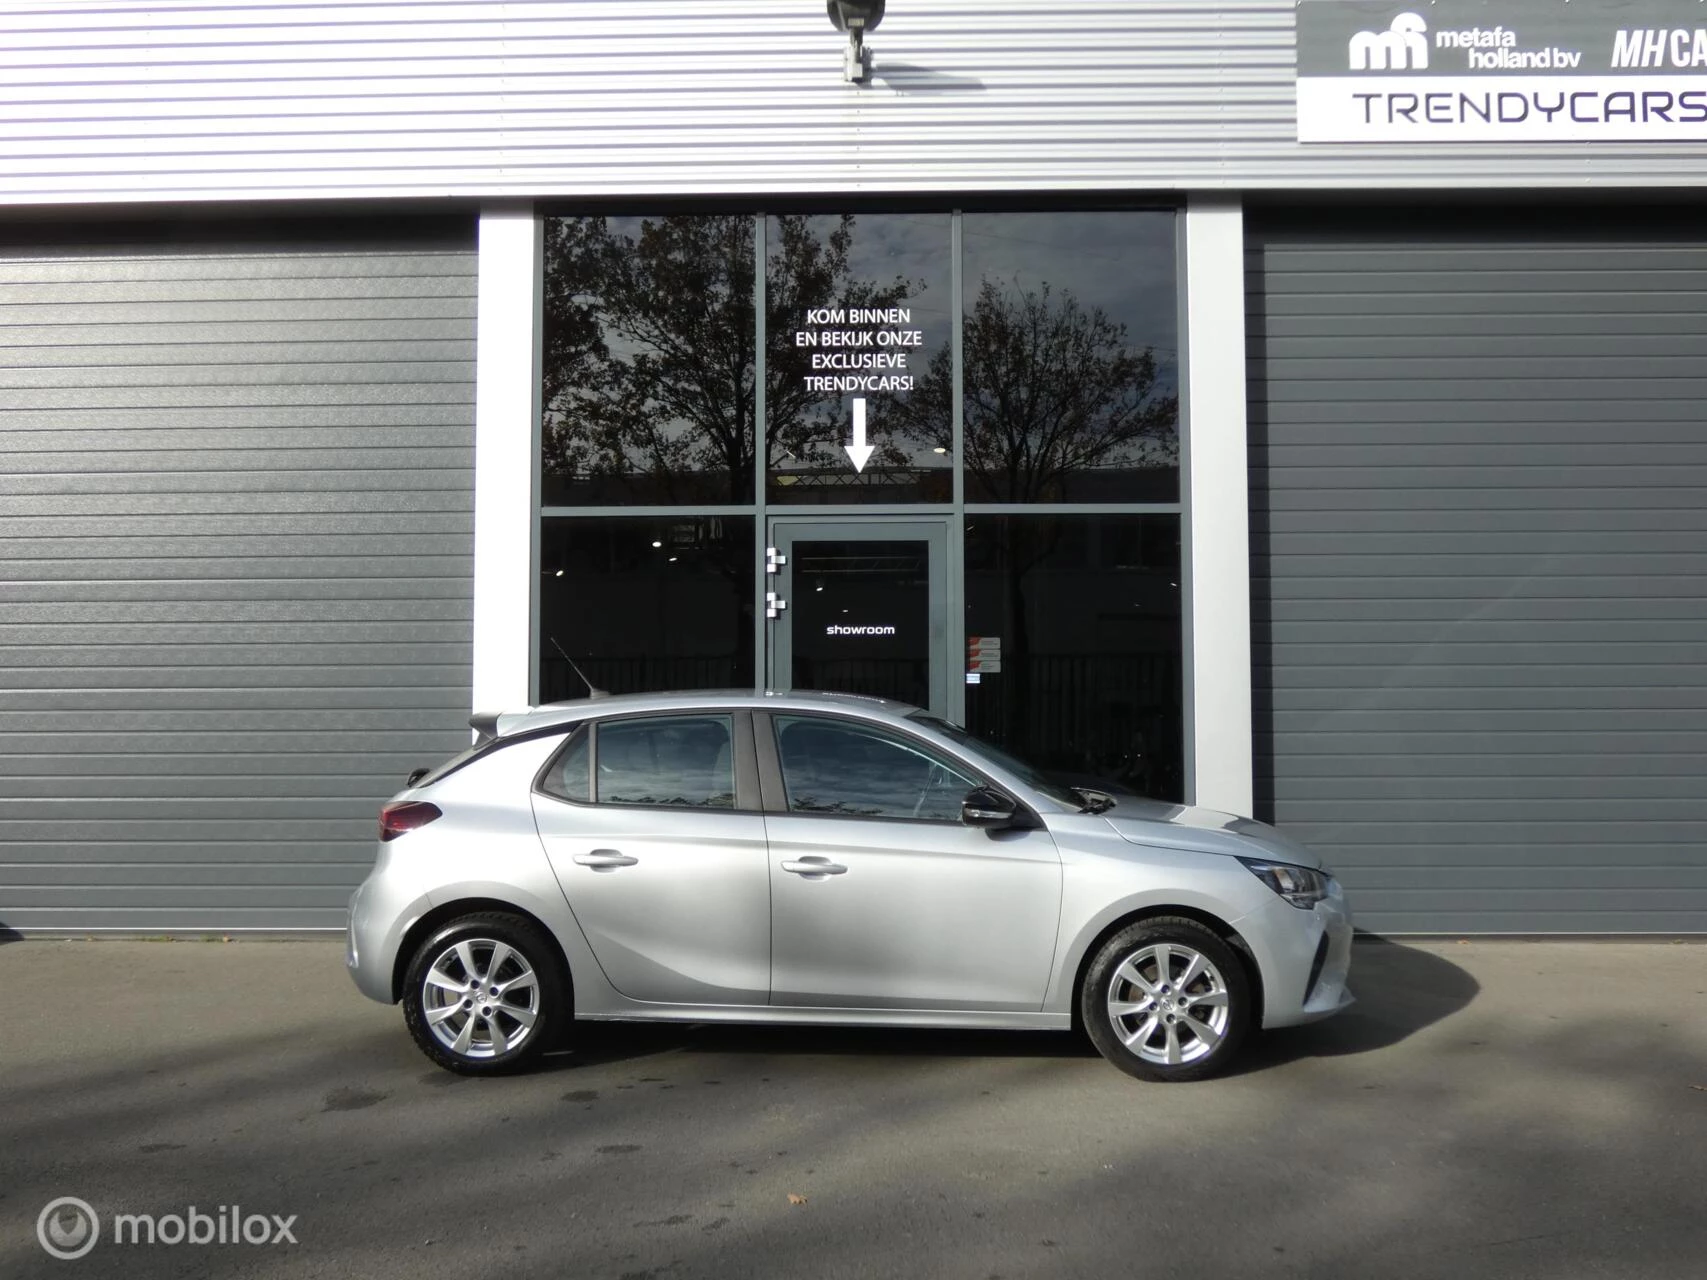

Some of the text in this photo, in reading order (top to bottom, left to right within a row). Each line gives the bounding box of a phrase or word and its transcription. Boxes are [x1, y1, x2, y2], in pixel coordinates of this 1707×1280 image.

[1436, 26, 1516, 48] metafa
[1469, 47, 1582, 69] holland bv
[1352, 91, 1707, 124] TRENDYCARS
[807, 308, 911, 324] KOM BINNEN
[796, 330, 922, 347] EN BEKIJK ONZE
[812, 353, 906, 369] EXCLUSIEVE
[804, 375, 914, 391] TRENDYCARS!
[826, 625, 895, 635] showroom
